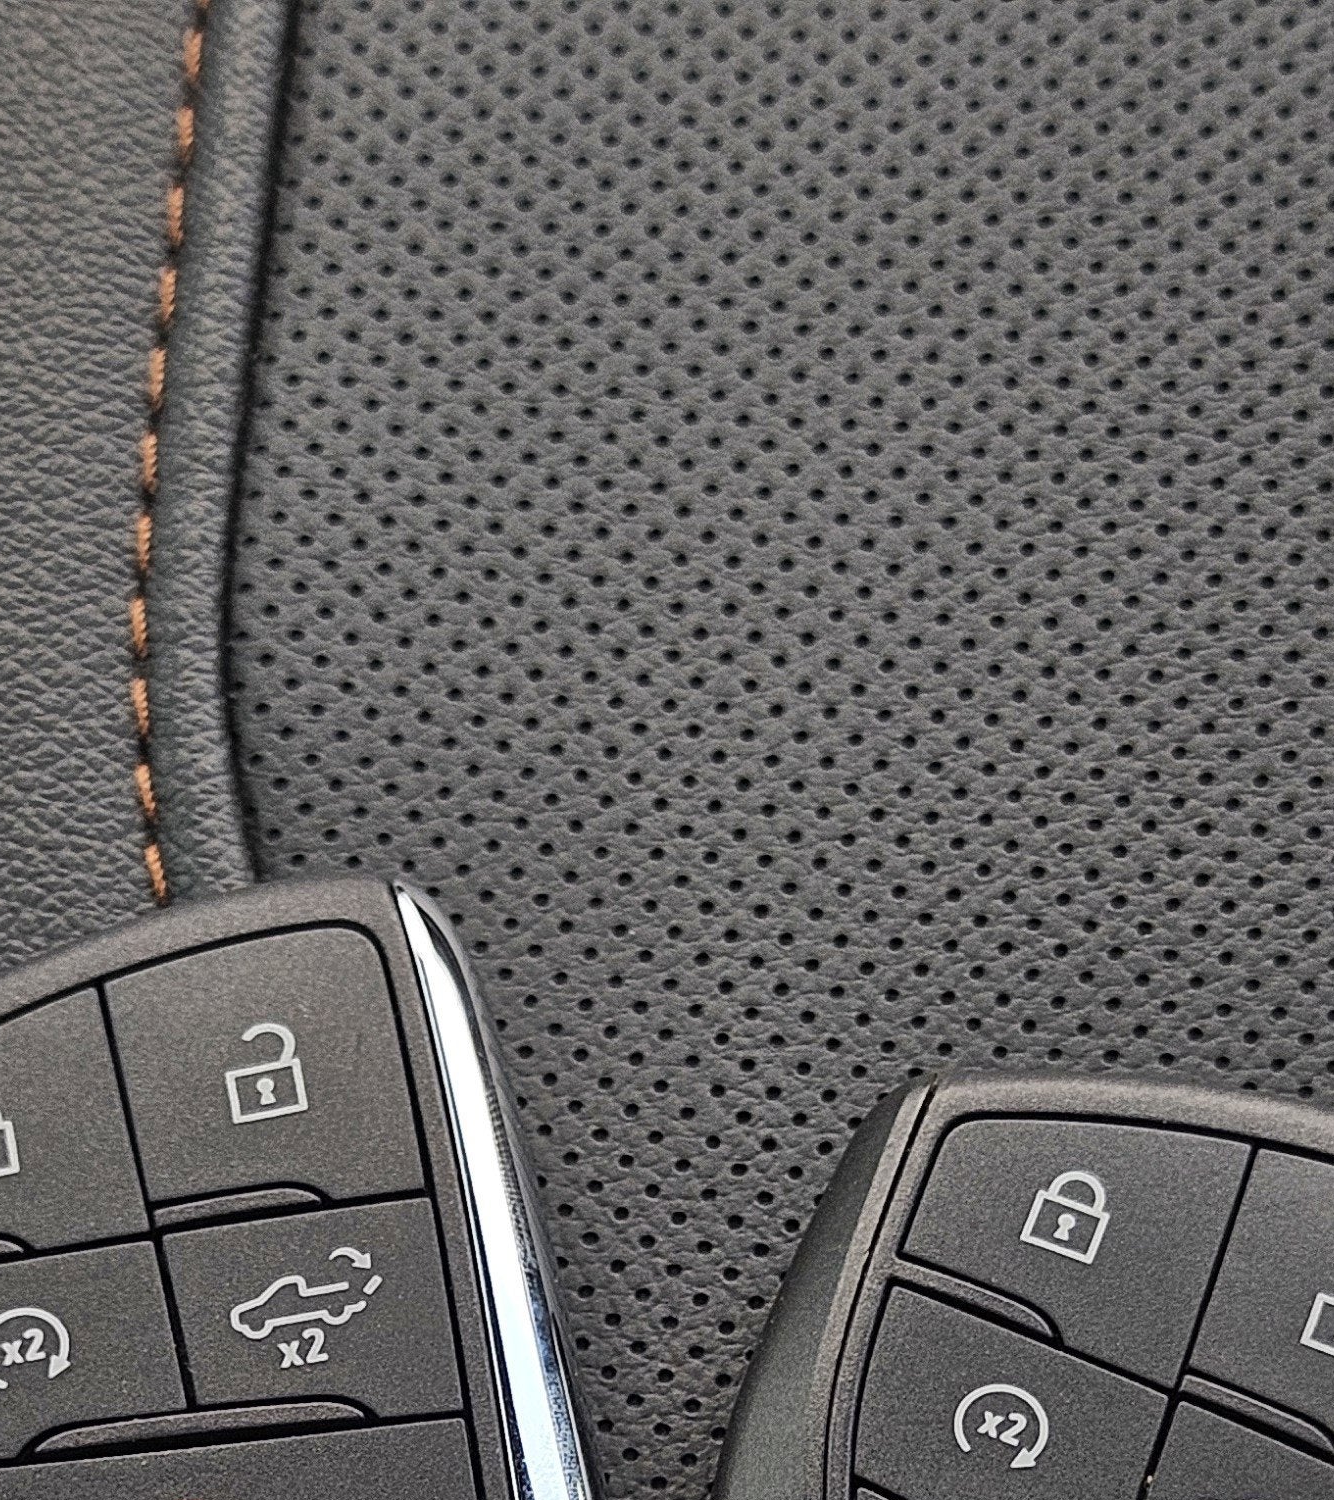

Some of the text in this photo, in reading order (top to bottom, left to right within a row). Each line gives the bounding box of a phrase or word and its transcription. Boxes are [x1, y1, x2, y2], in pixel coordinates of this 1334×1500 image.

[0, 1328, 46, 1367] x2
[279, 1328, 329, 1369] x2
[977, 1410, 1028, 1446] x2
